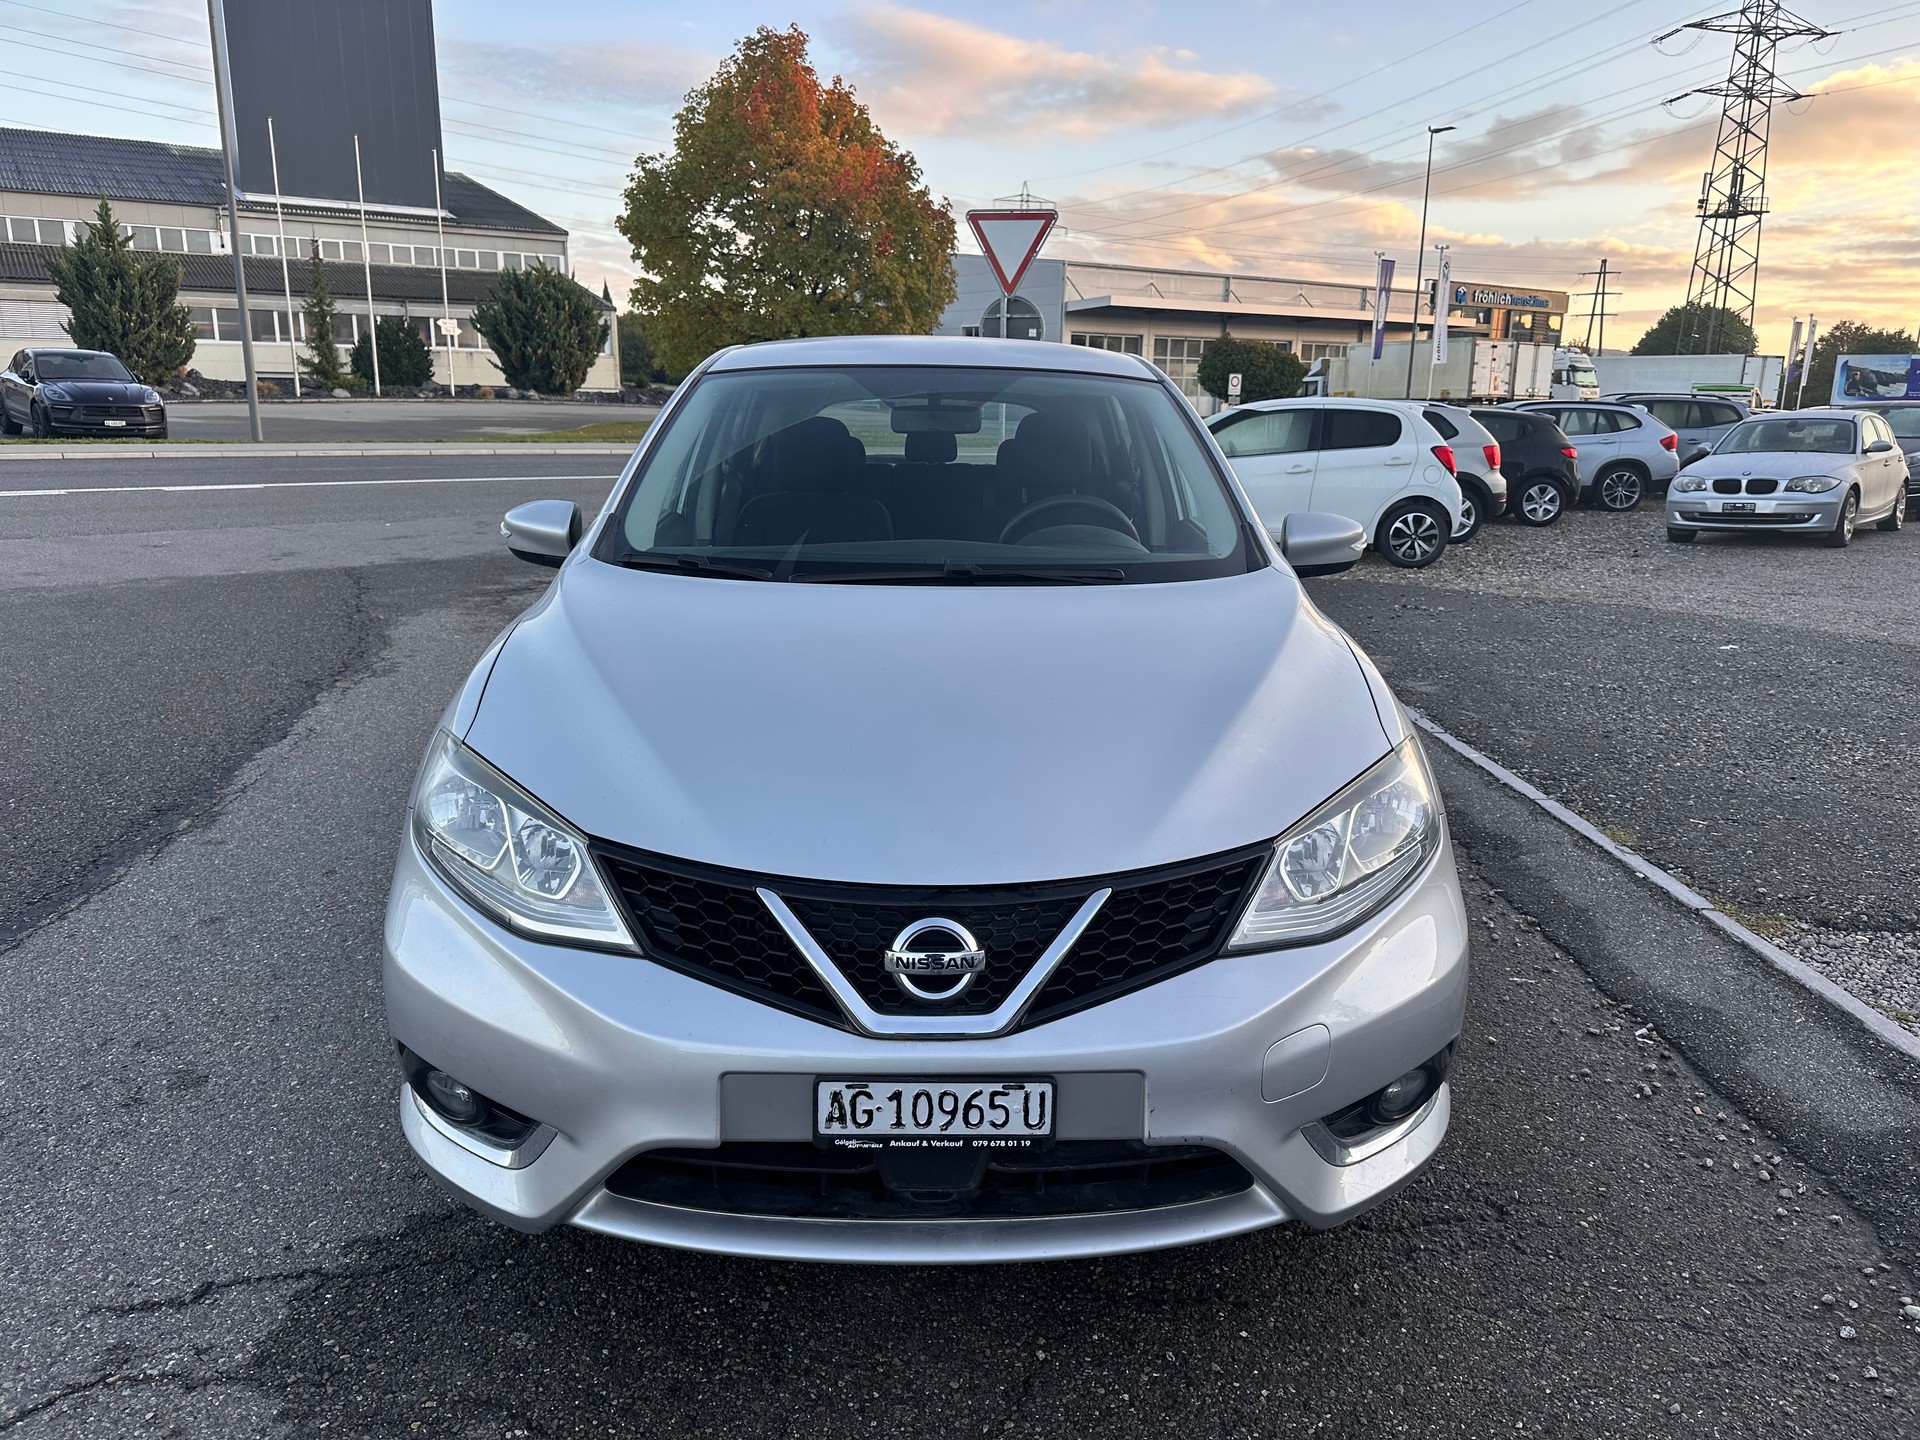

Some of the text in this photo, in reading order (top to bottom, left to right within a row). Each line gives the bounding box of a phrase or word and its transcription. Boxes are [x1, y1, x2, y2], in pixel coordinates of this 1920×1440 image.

[895, 956, 975, 970] NISSAN
[889, 1139, 920, 1147] Ankauf
[930, 1139, 964, 1147] Verkauf
